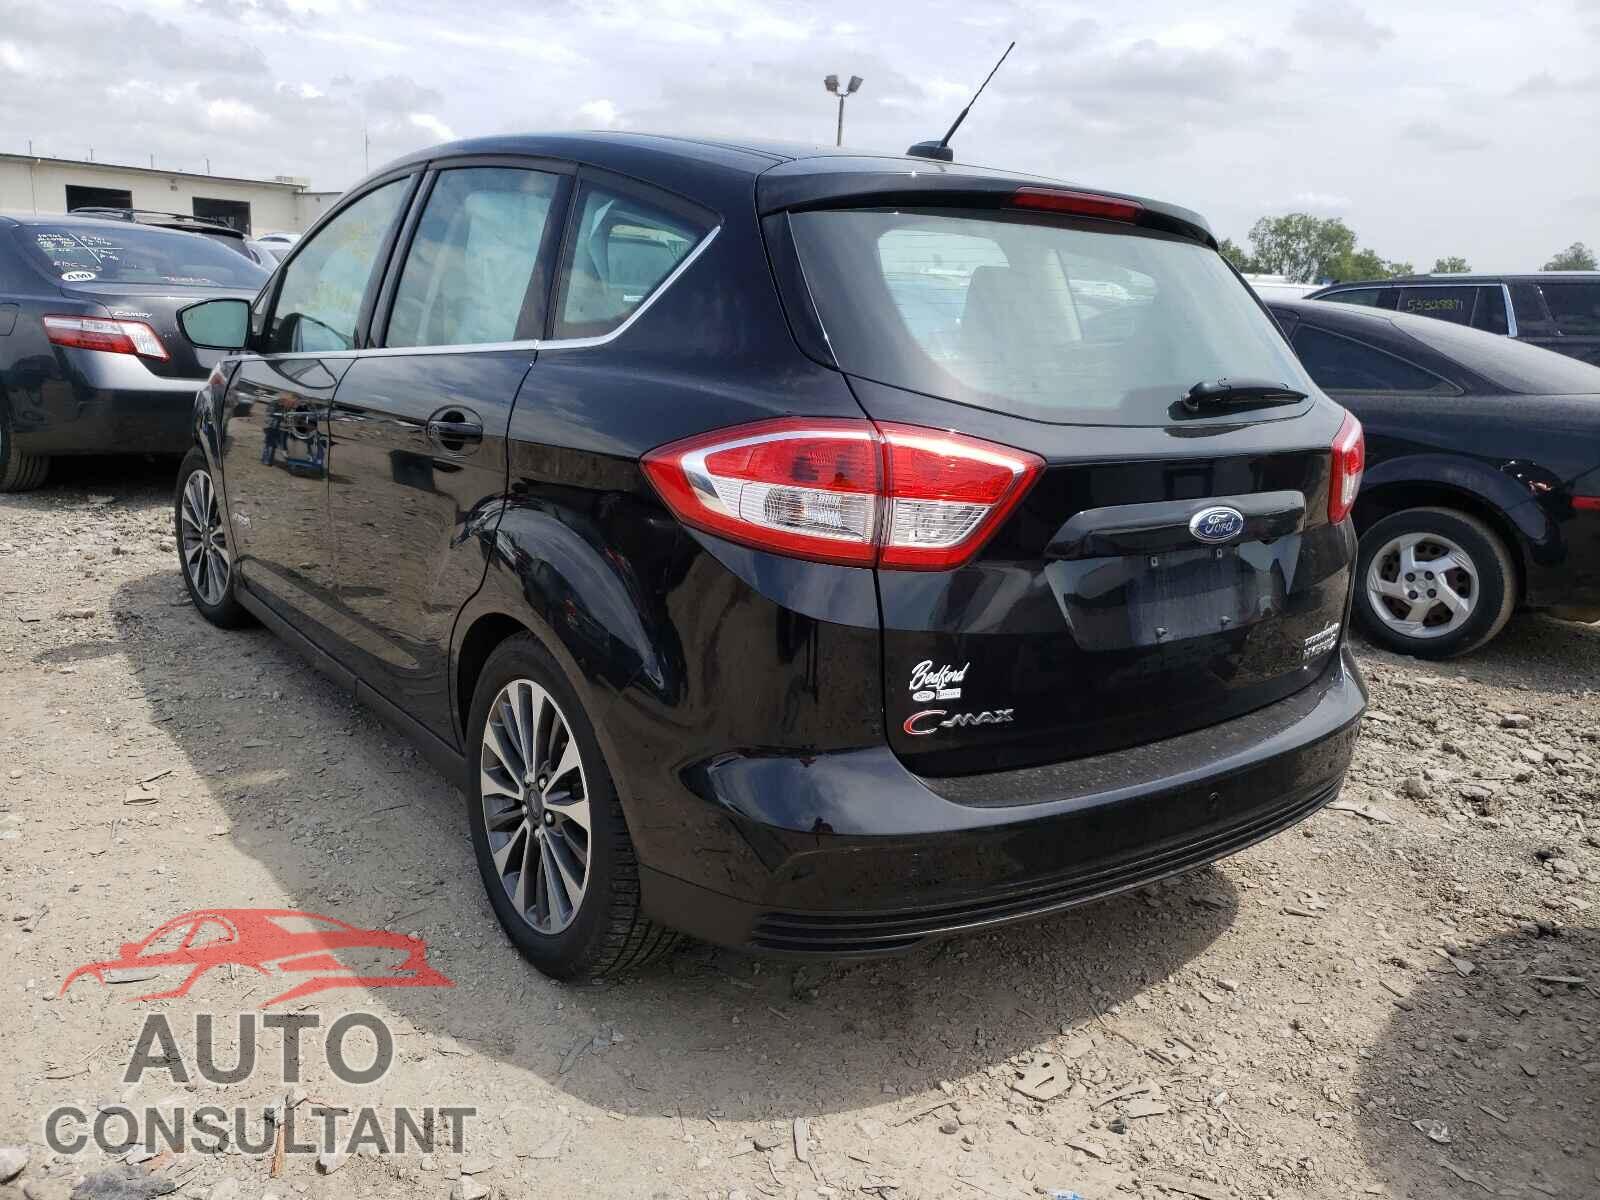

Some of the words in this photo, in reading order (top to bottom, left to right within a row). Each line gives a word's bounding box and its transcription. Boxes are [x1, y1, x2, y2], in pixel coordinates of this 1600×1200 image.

[1205, 513, 1235, 535] Ford
[909, 660, 970, 690] Bedford
[903, 708, 1015, 735] C-MAX
